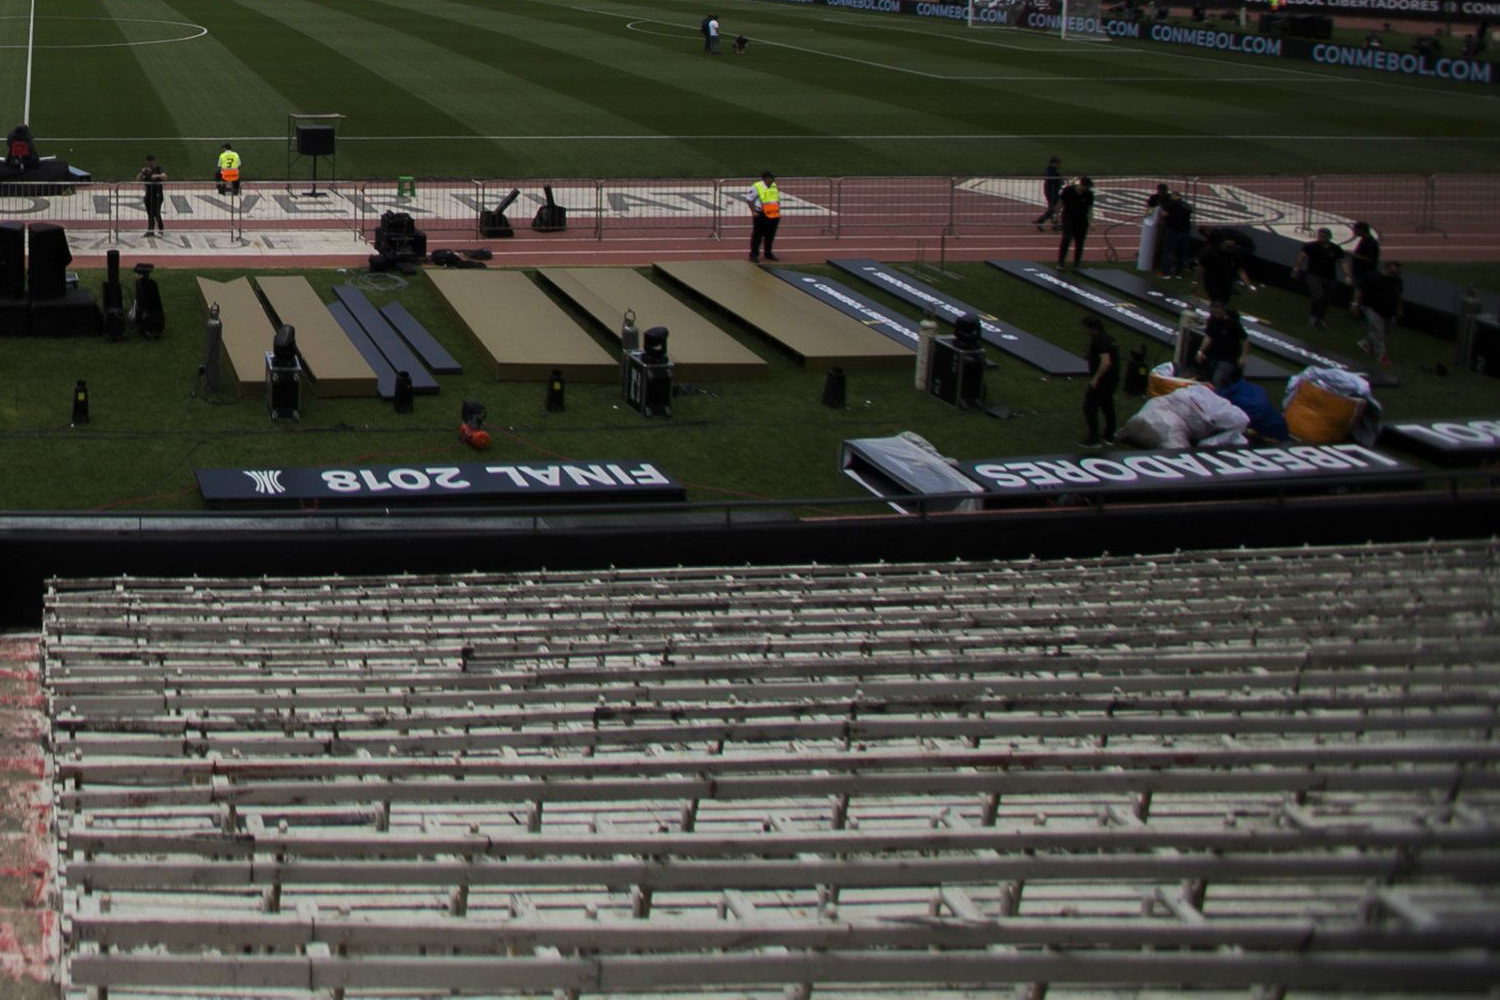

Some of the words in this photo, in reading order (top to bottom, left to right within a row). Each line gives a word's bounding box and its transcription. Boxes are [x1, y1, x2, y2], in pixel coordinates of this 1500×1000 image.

[1151, 24, 1283, 56] CONMEBOL.COM
[1312, 43, 1491, 83] CONMEBOL.COM
[321, 467, 471, 493] 2018
[486, 463, 670, 488] FINAL
[973, 443, 1399, 490] LIBERTADORES
